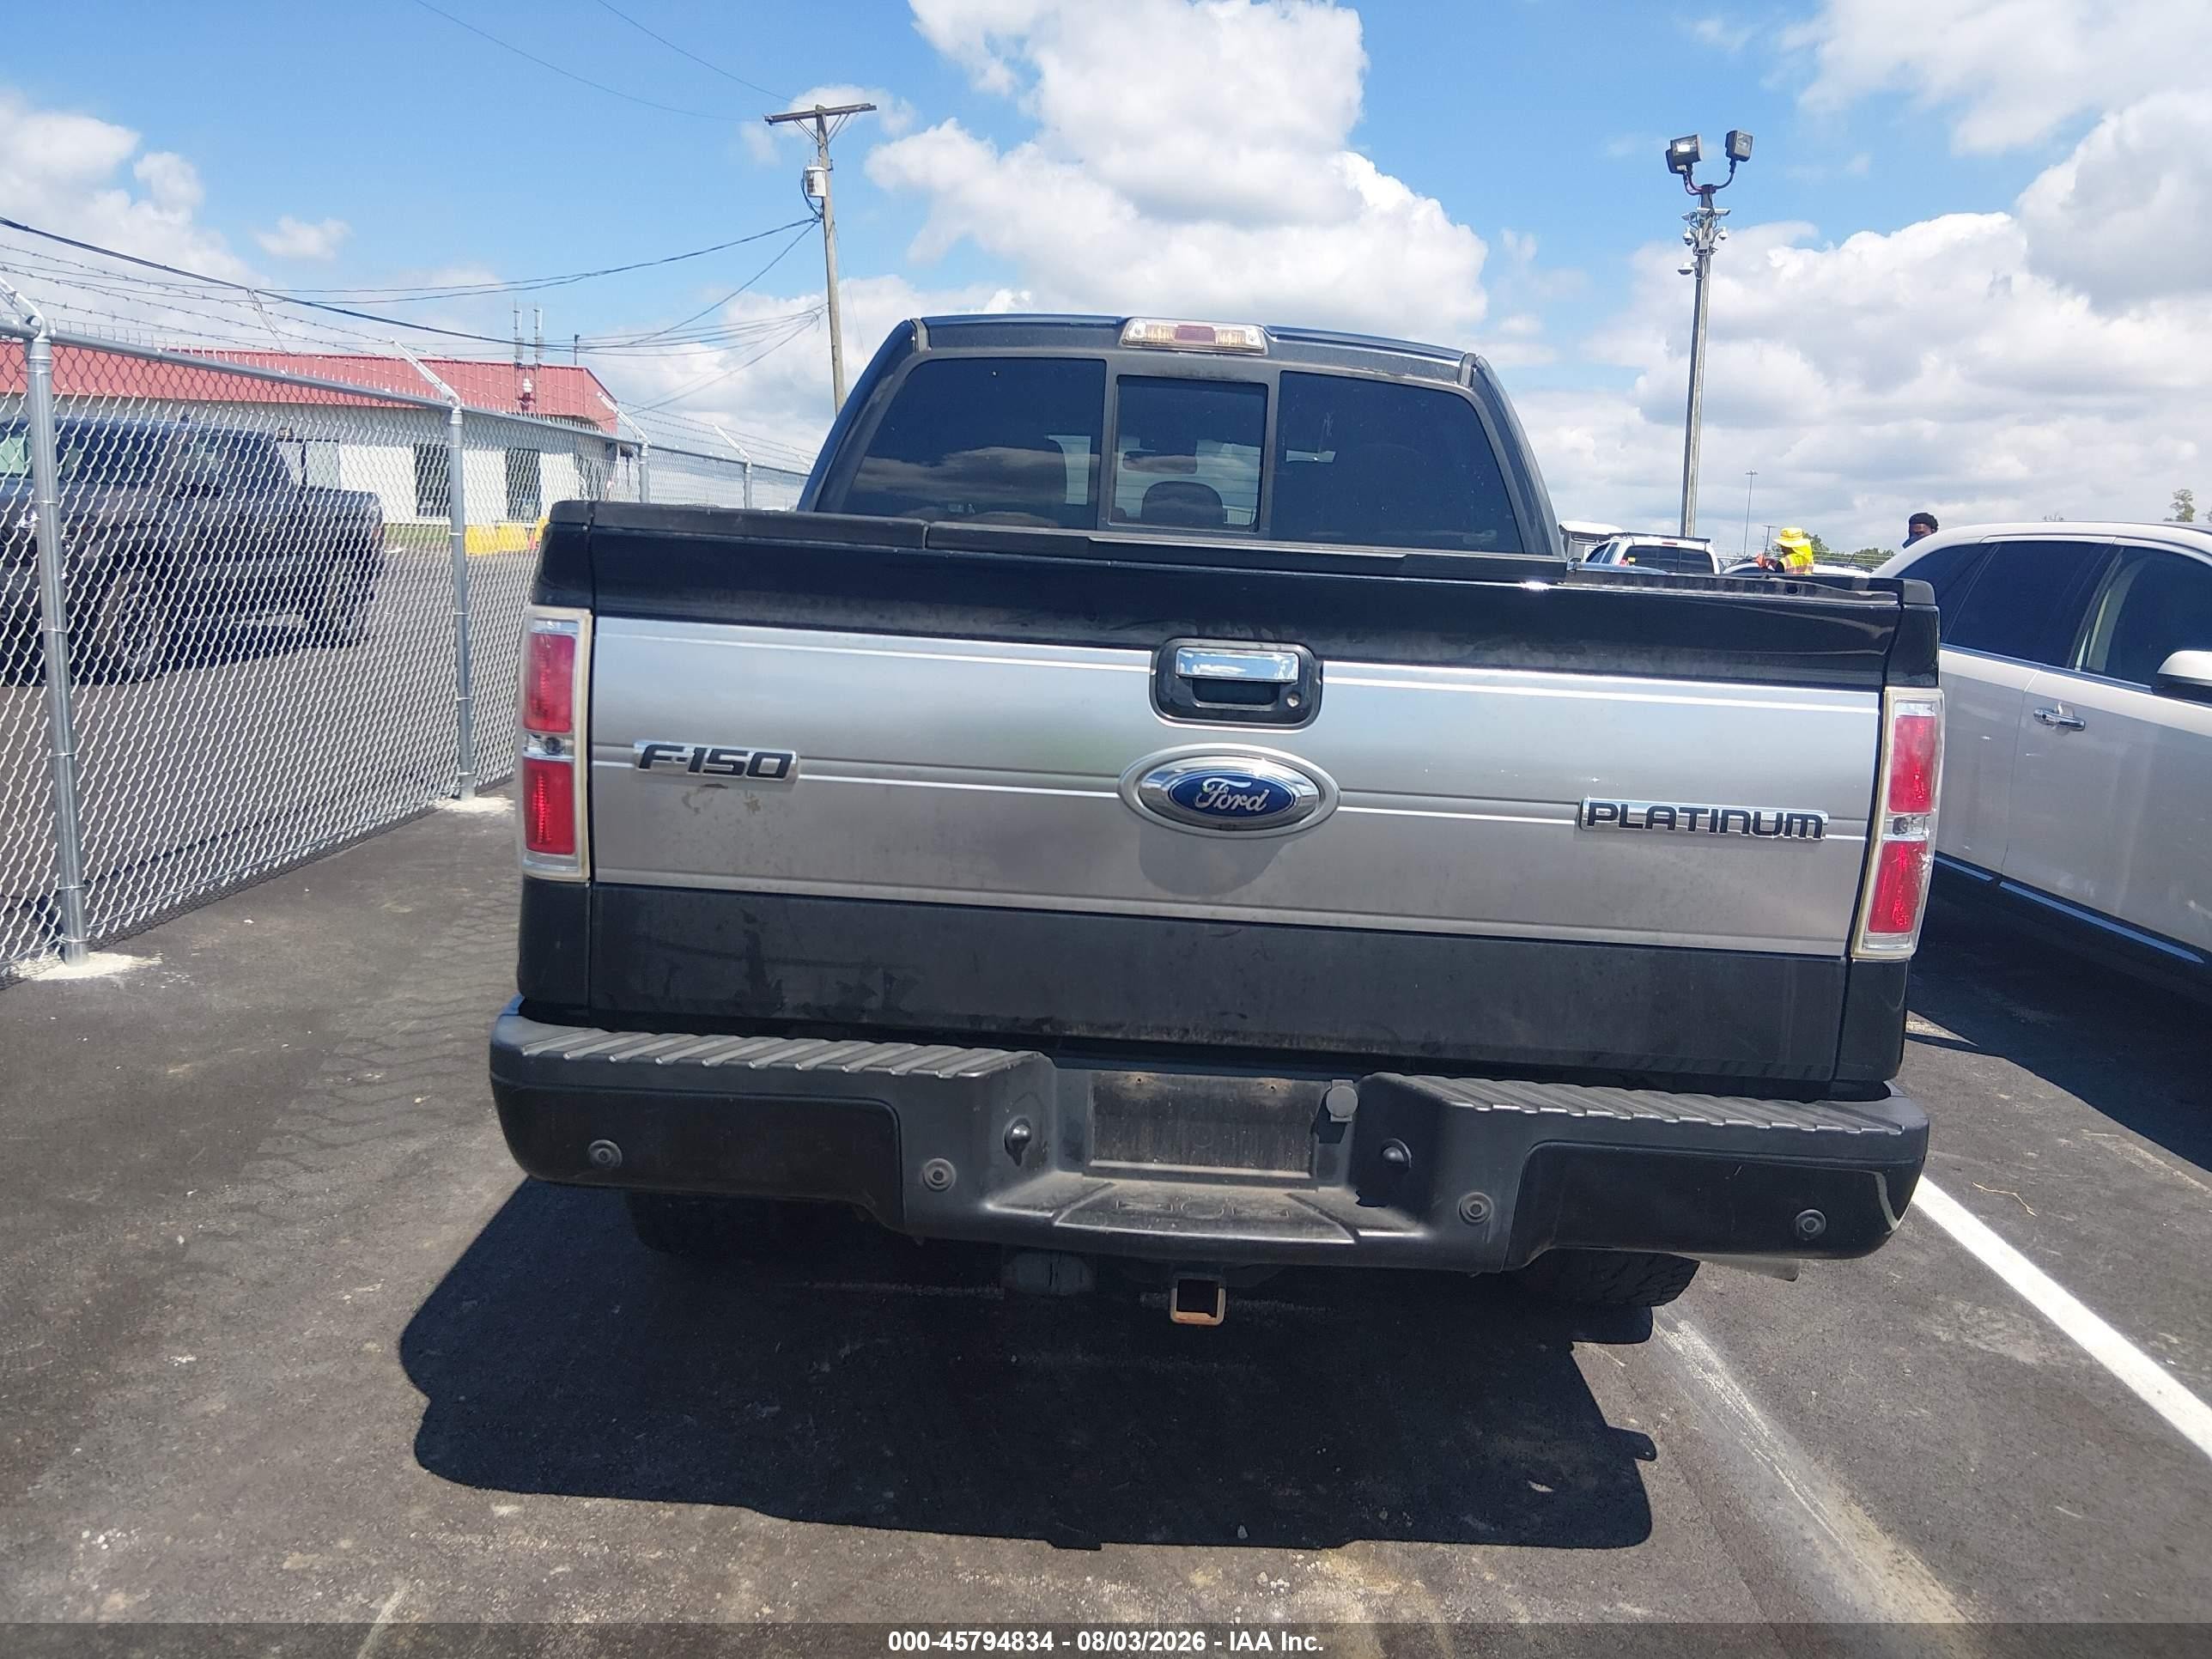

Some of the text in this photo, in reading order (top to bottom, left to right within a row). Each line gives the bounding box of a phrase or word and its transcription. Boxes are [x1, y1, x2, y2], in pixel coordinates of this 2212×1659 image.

[638, 744, 794, 780] F-150
[1194, 777, 1271, 811] Ford
[1586, 800, 1823, 840] PLATINUM
